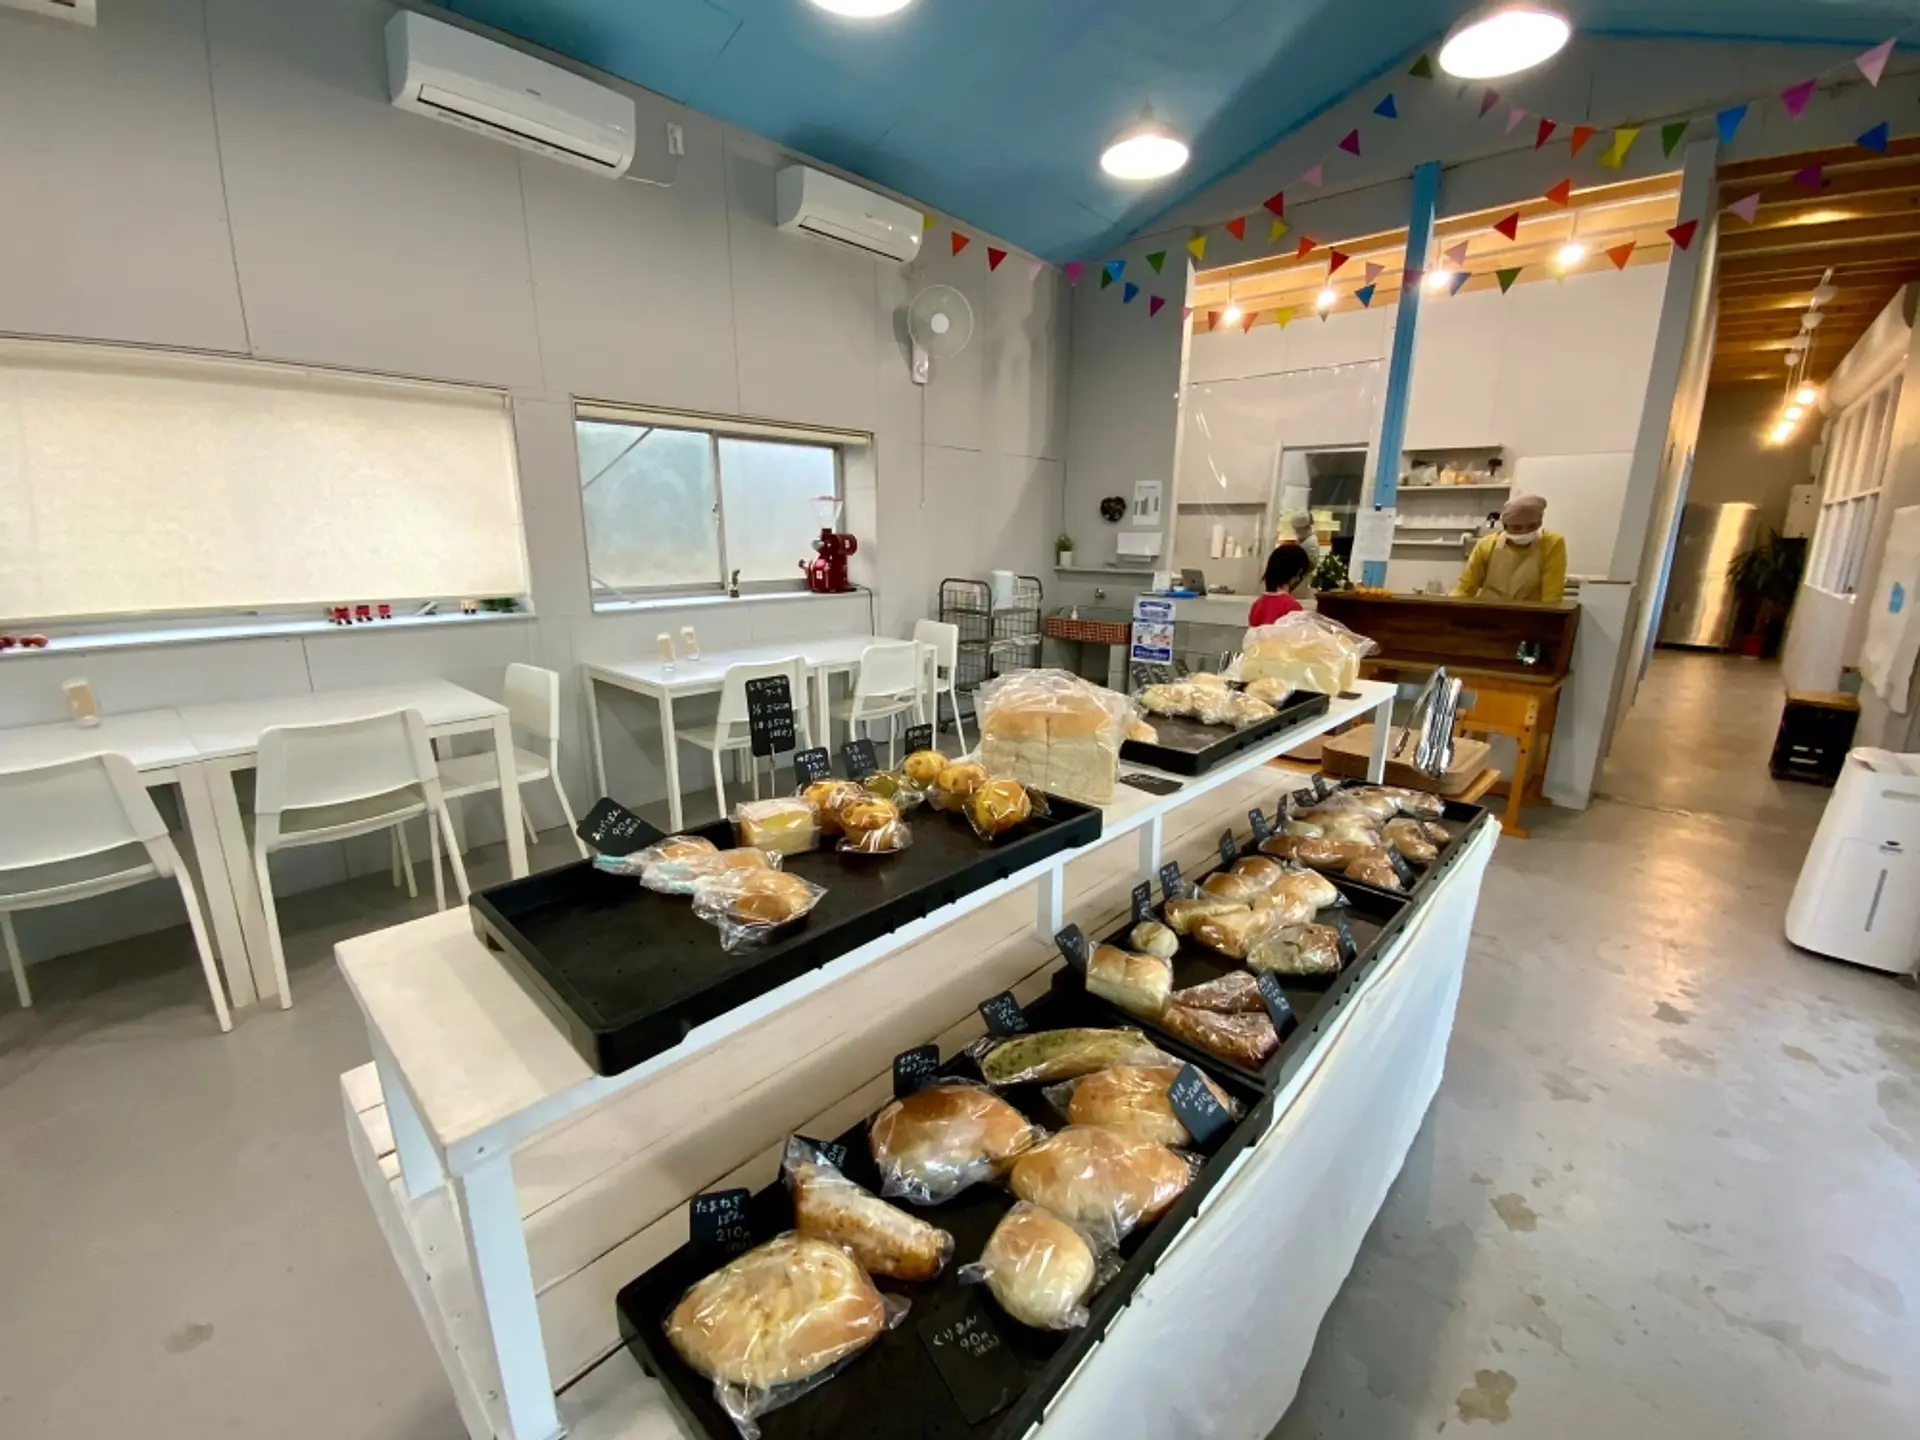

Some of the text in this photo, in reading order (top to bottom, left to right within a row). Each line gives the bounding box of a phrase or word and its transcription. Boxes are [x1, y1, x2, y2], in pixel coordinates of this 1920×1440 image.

[695, 1195, 743, 1214] たまねぎ
[717, 1210, 745, 1226] ぱん
[932, 1315, 977, 1346] くりあん
